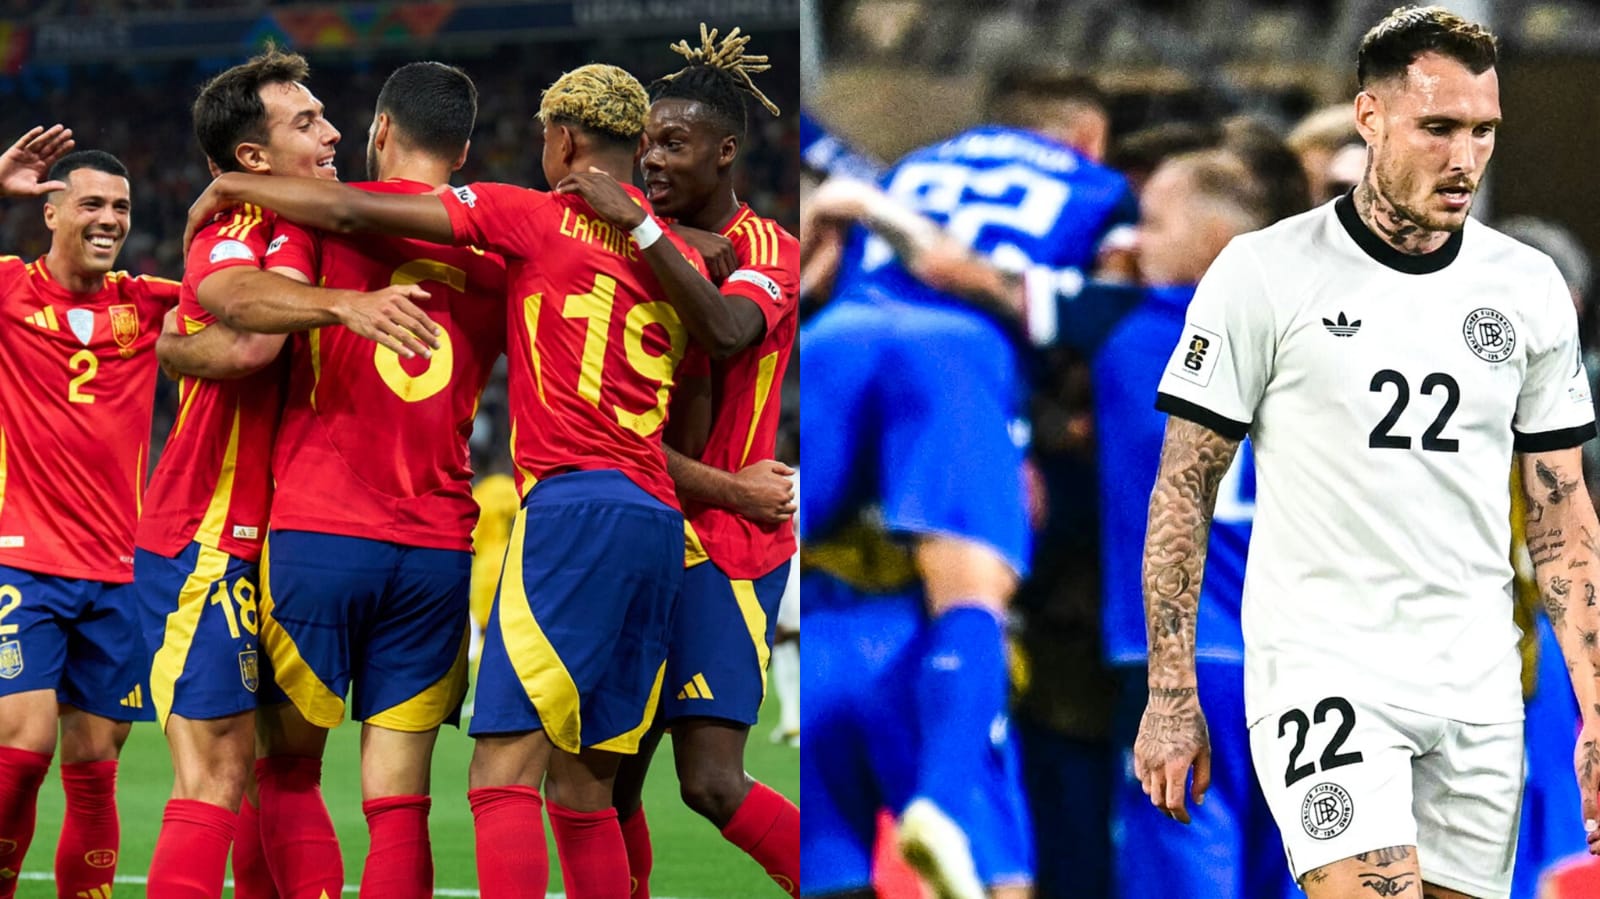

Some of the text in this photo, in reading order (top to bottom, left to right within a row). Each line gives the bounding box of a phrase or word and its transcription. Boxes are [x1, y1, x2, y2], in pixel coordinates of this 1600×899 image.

[560, 207, 638, 262] LAMINE
[68, 349, 98, 404] 2
[562, 273, 688, 438] 19
[1368, 368, 1461, 453] 22
[0, 584, 22, 634] 2
[211, 576, 258, 639] 18
[1277, 696, 1364, 788] 22
